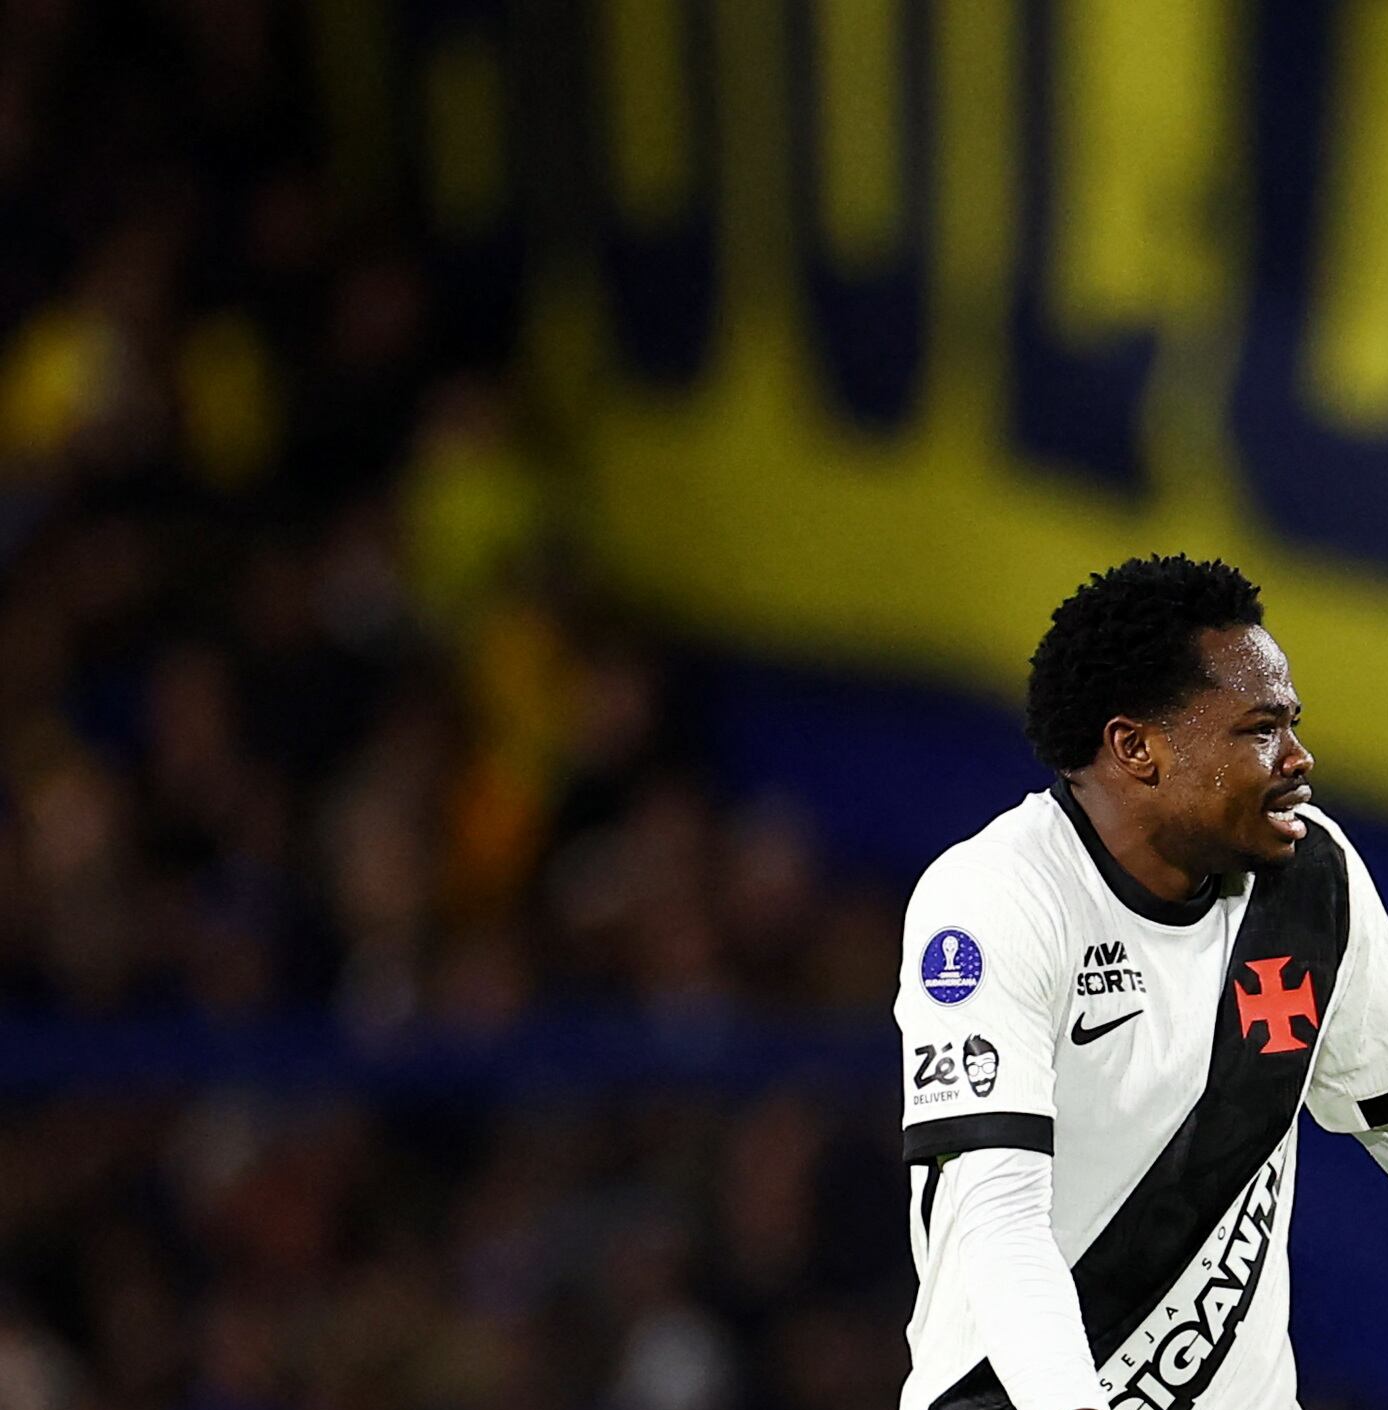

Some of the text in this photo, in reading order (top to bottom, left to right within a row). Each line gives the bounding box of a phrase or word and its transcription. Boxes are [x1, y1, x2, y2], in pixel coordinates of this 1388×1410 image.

[913, 1041, 960, 1090] Zé
[913, 1089, 960, 1106] DELIVERY
[1099, 1304, 1180, 1393] SEJA
